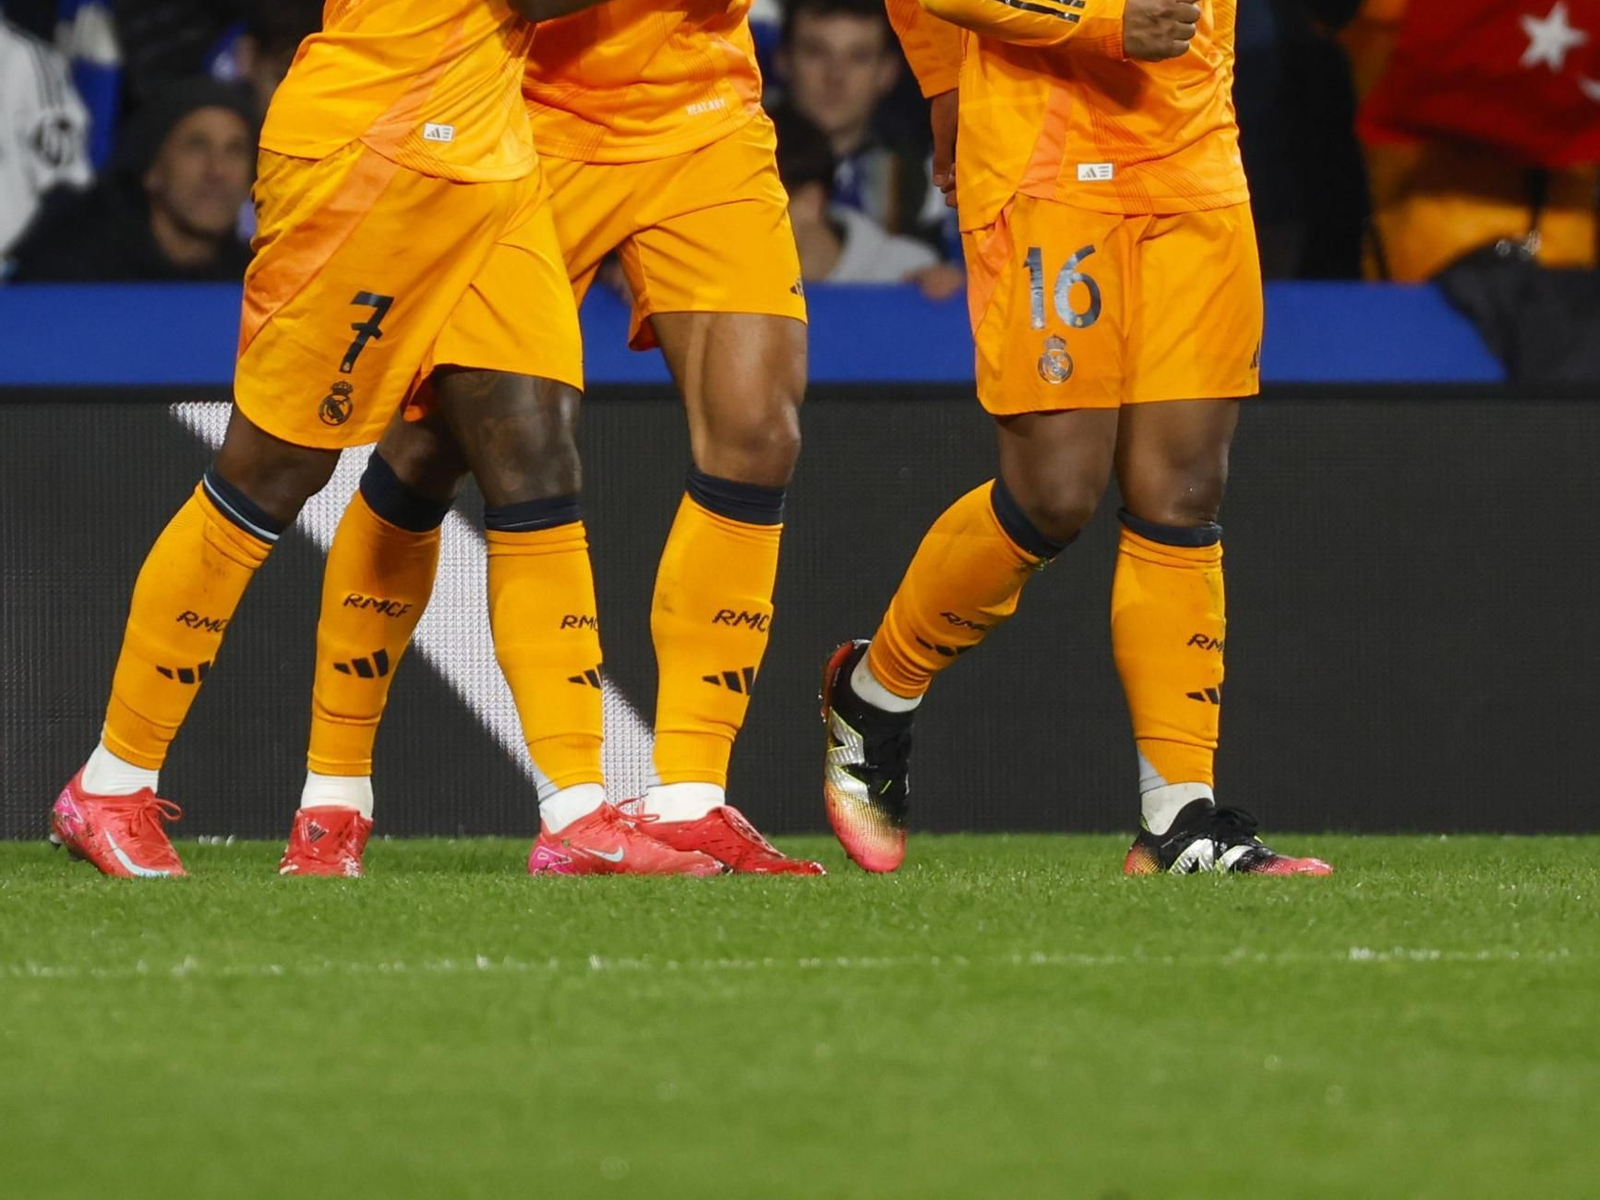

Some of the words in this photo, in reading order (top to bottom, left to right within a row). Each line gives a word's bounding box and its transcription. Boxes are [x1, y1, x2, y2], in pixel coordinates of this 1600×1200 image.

[1023, 244, 1102, 330] 16
[339, 290, 395, 374] 7
[343, 593, 413, 618] RMCF
[176, 610, 229, 632] RMC
[711, 608, 770, 632] RMC
